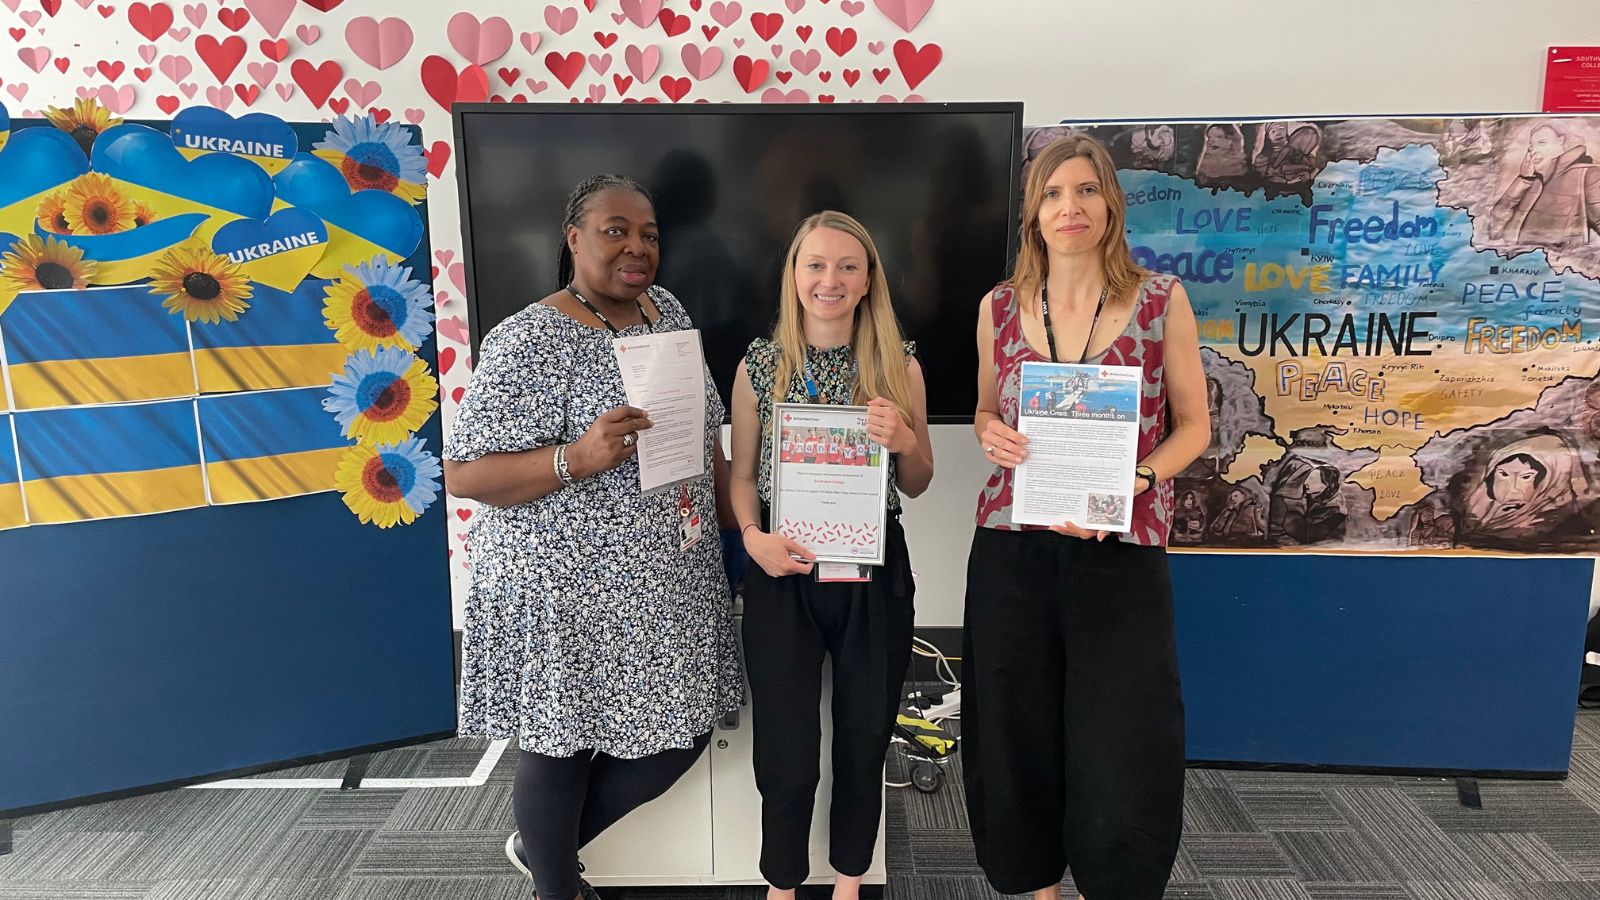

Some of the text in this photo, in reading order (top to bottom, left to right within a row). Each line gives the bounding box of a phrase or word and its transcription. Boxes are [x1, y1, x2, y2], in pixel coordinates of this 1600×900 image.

[185, 134, 284, 158] UKRAINE
[1125, 186, 1182, 207] eedom
[1175, 207, 1252, 235] LOVE
[1309, 200, 1438, 244] Freedom
[228, 231, 319, 264] UKRAINE
[1243, 262, 1443, 293] LOVE FAMILY
[1364, 291, 1428, 306] FREEDOM
[1462, 281, 1562, 305] PEACE
[1521, 305, 1582, 321] family
[1238, 312, 1437, 356] UKRAINE
[1464, 317, 1583, 354] FREEDOM
[1276, 360, 1385, 402] PEACE
[1440, 387, 1484, 400] SAFETY
[1024, 408, 1048, 416] Ukraine
[1363, 406, 1425, 430] HOPE
[784, 441, 838, 453] Thank
[1369, 469, 1407, 480] PEACE
[1379, 489, 1402, 499] LOVE
